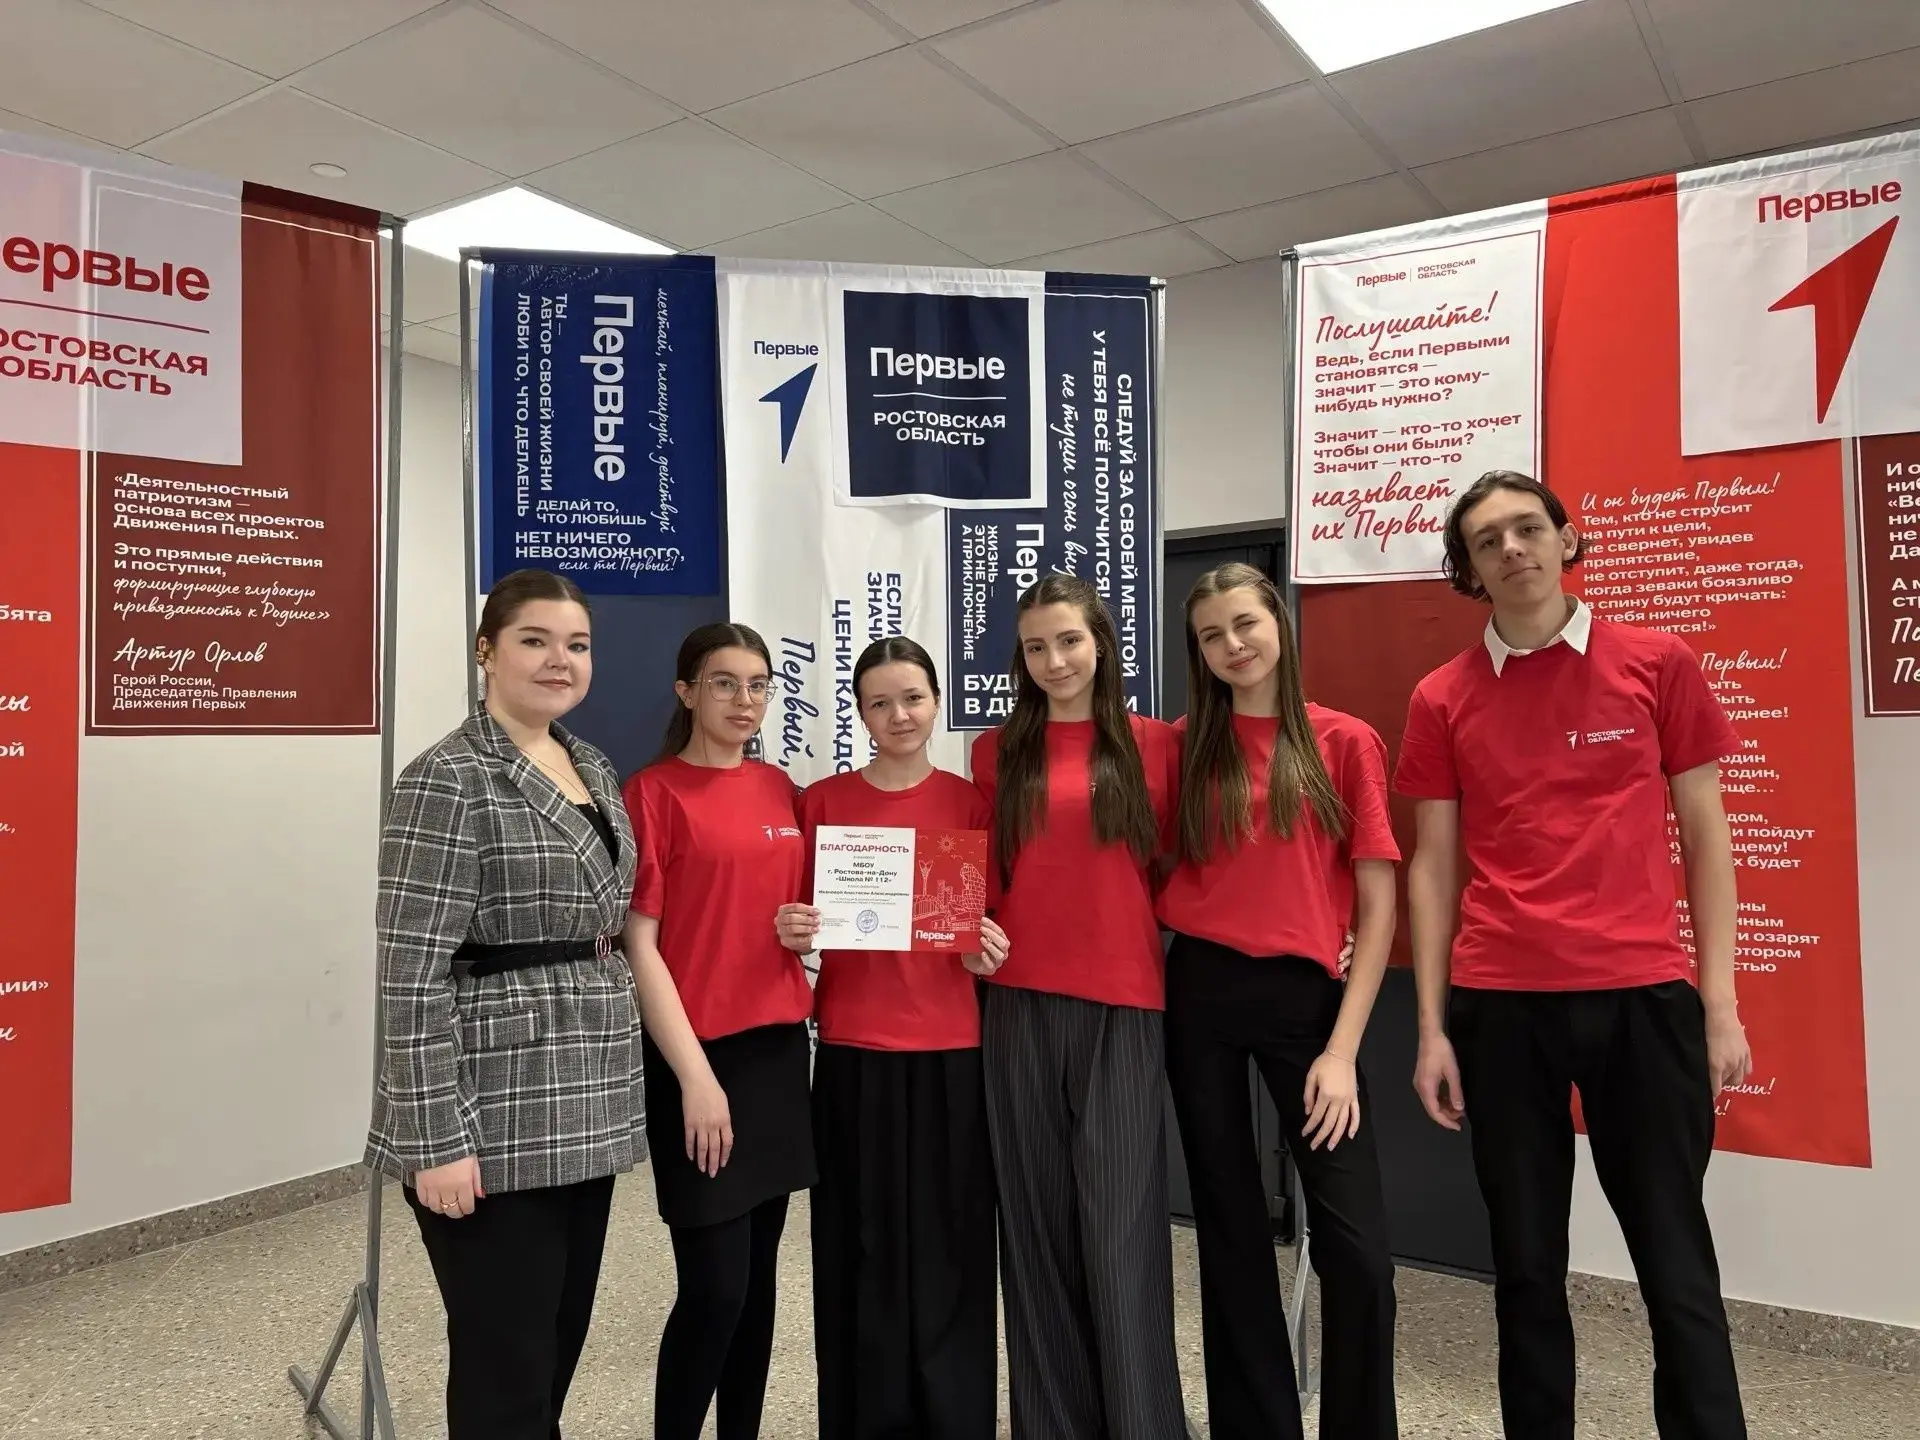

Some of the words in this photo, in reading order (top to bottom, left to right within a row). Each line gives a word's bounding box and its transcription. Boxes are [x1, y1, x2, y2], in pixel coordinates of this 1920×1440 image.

[1758, 181, 1901, 223] Первые
[2, 235, 210, 301] ервые
[1417, 258, 1475, 273] РОСТОВСКАЯ
[1417, 268, 1458, 280] ОБЛАСТЬ
[1357, 271, 1406, 287] Первые
[556, 294, 567, 319] ТЫ
[517, 293, 530, 349] ЛЮБИ
[540, 297, 552, 354] АВТОР
[656, 288, 673, 356] мечтай,
[1315, 290, 1499, 351] Послушайте!
[753, 340, 819, 359] Первые
[1093, 330, 1105, 343] У
[0, 329, 208, 376] СТОВСКАЯ
[1315, 354, 1364, 368] Ведь,
[1369, 348, 1413, 361] если
[1418, 335, 1510, 356] Первыми
[514, 353, 529, 381] ТО,
[870, 346, 1006, 385] Первые
[1093, 347, 1107, 403] ТЕБЯ
[1315, 363, 1418, 383] становятся
[539, 359, 555, 420] СВОЕЙ
[580, 295, 634, 482] Первые
[1062, 373, 1075, 398] не
[1315, 383, 1376, 398] значит
[1399, 377, 1430, 389] это
[1434, 370, 1490, 386] кому-
[517, 386, 529, 421] ЧТО
[1315, 398, 1377, 414] нибудь
[1382, 388, 1453, 408] нужно?
[873, 410, 1006, 428] РОСТОВСКАЯ
[1094, 408, 1111, 453] ВСЁ
[1117, 373, 1137, 464] СЛЕДУЙ
[1314, 429, 1378, 444] Значит
[1401, 421, 1462, 436] кто-то
[1466, 414, 1522, 429] хочет
[896, 427, 985, 446] ОБЛАСТЬ
[1050, 403, 1078, 474] туши
[1313, 445, 1369, 459] чтобы
[1373, 443, 1407, 454] они
[1412, 433, 1474, 449] были?
[540, 424, 552, 491] ЖИЗНИ
[1313, 460, 1378, 474] Значит
[1400, 453, 1462, 467] кто-то
[1886, 463, 1902, 476] И
[515, 425, 530, 517] ДЕЛАЕШЬ
[1119, 469, 1134, 499] ЗА
[114, 473, 289, 499] «Деятельностный
[114, 489, 232, 508] патриотизм
[649, 452, 678, 533] действуй
[1312, 471, 1456, 517] называет
[1581, 493, 1597, 511] И
[1604, 497, 1625, 509] он
[1631, 487, 1690, 515] будет
[1694, 472, 1780, 506] Первым!
[114, 503, 186, 518] основа
[191, 510, 235, 521] всех
[239, 514, 324, 529] проектов
[536, 499, 590, 512] ДЕЛАЙ
[594, 501, 619, 514] ТО,
[1064, 480, 1077, 532] огонь
[1582, 516, 1619, 527] Тем,
[1623, 512, 1651, 523] кто
[1655, 510, 1677, 519] не
[1681, 504, 1752, 517] струсит
[114, 515, 217, 534] Движения
[221, 523, 299, 540] Первых.
[536, 514, 567, 523] ЧТО
[571, 514, 646, 525] ЛЮБИШЬ
[962, 525, 972, 535] А
[1312, 517, 1345, 541] их
[1353, 503, 1448, 553] Первы
[1582, 529, 1603, 540] на
[1606, 527, 1645, 540] пути
[1649, 525, 1659, 534] к
[1662, 521, 1712, 534] цели,
[515, 532, 552, 543] НЕТ
[557, 532, 631, 544] НИЧЕГО
[975, 525, 985, 558] ЭТО
[1120, 503, 1138, 580] СВОЕЙ
[1608, 538, 1683, 554] свернет,
[1688, 532, 1753, 547] увидев
[114, 542, 151, 557] Это
[156, 547, 232, 563] прямые
[236, 553, 323, 568] действия
[515, 546, 684, 561] НЕВОЗМОЖНОГО,
[988, 525, 998, 583] ЖИЗНЬ
[1007, 524, 1044, 601] Пер
[1052, 541, 1088, 578] вну
[1583, 551, 1700, 569] препятствие,
[114, 560, 126, 569] и
[132, 561, 226, 577] поступки,
[558, 561, 590, 570] если
[593, 560, 616, 570] ты
[620, 556, 677, 578] Первый!
[975, 560, 985, 580] НЕ
[1584, 572, 1604, 582] не
[1608, 566, 1689, 581] отступит,
[1694, 563, 1742, 575] даже
[1746, 559, 1803, 572] тогда,
[113, 577, 240, 600] формирующие
[245, 581, 315, 605] глубокую
[1584, 586, 1632, 597] когда
[1636, 579, 1698, 591] зеваки
[1702, 574, 1793, 588] боязливо
[1892, 578, 1908, 590] А
[113, 596, 242, 620] привязанность
[248, 607, 257, 618] к
[262, 602, 330, 626] Родине»
[887, 574, 901, 634] ЕСЛИ
[962, 539, 974, 660] ПРИКЛЮЧЕНИЕ
[975, 583, 986, 639] ГОНКА,
[1599, 598, 1649, 610] спину
[1653, 593, 1701, 607] будут
[1705, 590, 1786, 603] кричать:
[0, 605, 52, 622] бята
[1606, 612, 1645, 623] тебя
[1649, 607, 1711, 621] ничего
[832, 600, 852, 672] ЦЕНИ
[1121, 585, 1140, 677] МЕЧТОЙ
[113, 637, 195, 671] Артур
[204, 641, 267, 673] Орлов
[1701, 648, 1788, 680] Первым!
[113, 674, 156, 687] Герой
[160, 675, 215, 687] России,
[113, 686, 218, 698] Председатель
[222, 688, 297, 700] Правления
[113, 698, 188, 710] Движения
[192, 699, 246, 710] Первых
[772, 637, 819, 767] Первый,
[1725, 707, 1789, 721] уднее!
[1587, 729, 1634, 738] РОСТОВСКАЯ
[1588, 735, 1621, 743] ОБЛАСТЬ
[1728, 768, 1780, 779] один,
[1748, 827, 1815, 840] пойдут
[821, 844, 909, 853] БЛАГОДАРНОСТЬ
[1747, 856, 1801, 870] будет
[916, 930, 955, 942] Первые
[1754, 933, 1820, 945] озарят
